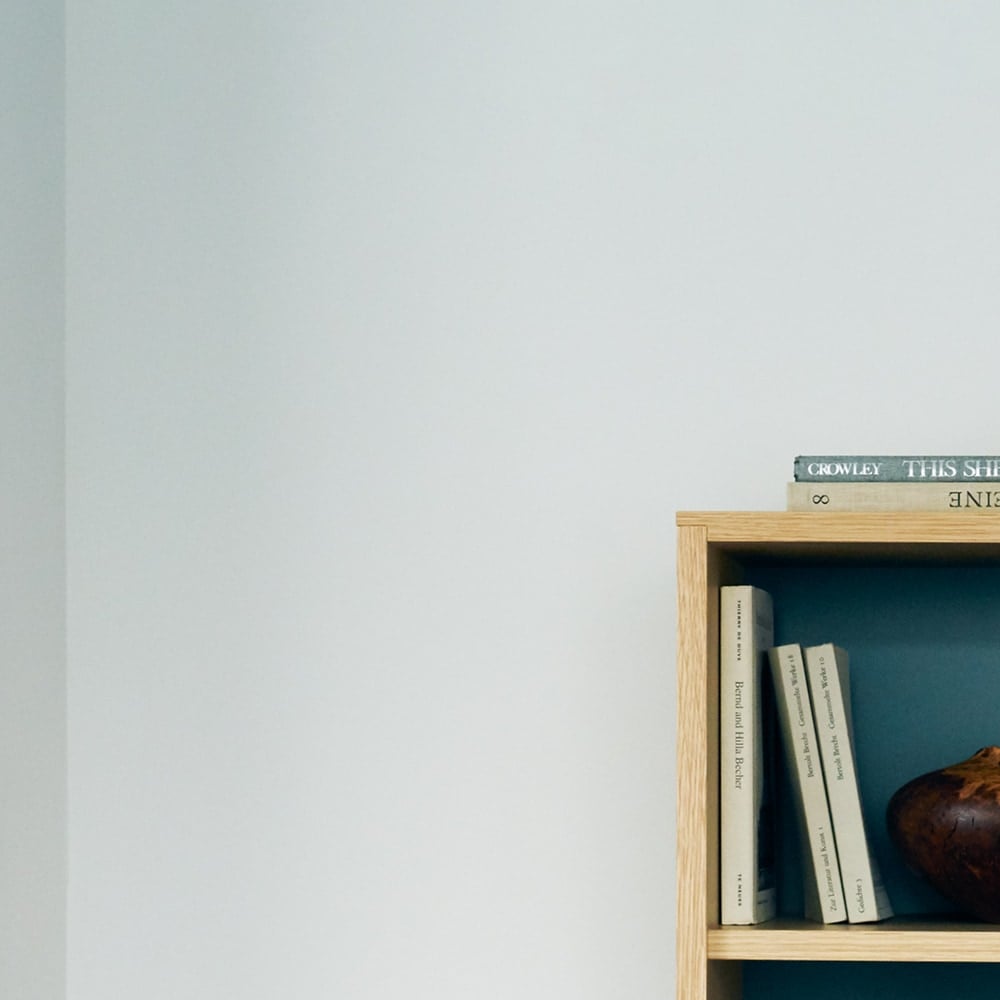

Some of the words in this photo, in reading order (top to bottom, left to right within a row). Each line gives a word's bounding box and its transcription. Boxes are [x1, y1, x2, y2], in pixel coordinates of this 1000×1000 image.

[807, 462, 883, 477] CROWLEY
[902, 459, 957, 478] THIS
[734, 681, 745, 709] Bernd
[734, 712, 744, 729] and
[734, 731, 744, 754] Hilla
[734, 756, 744, 790] Becher
